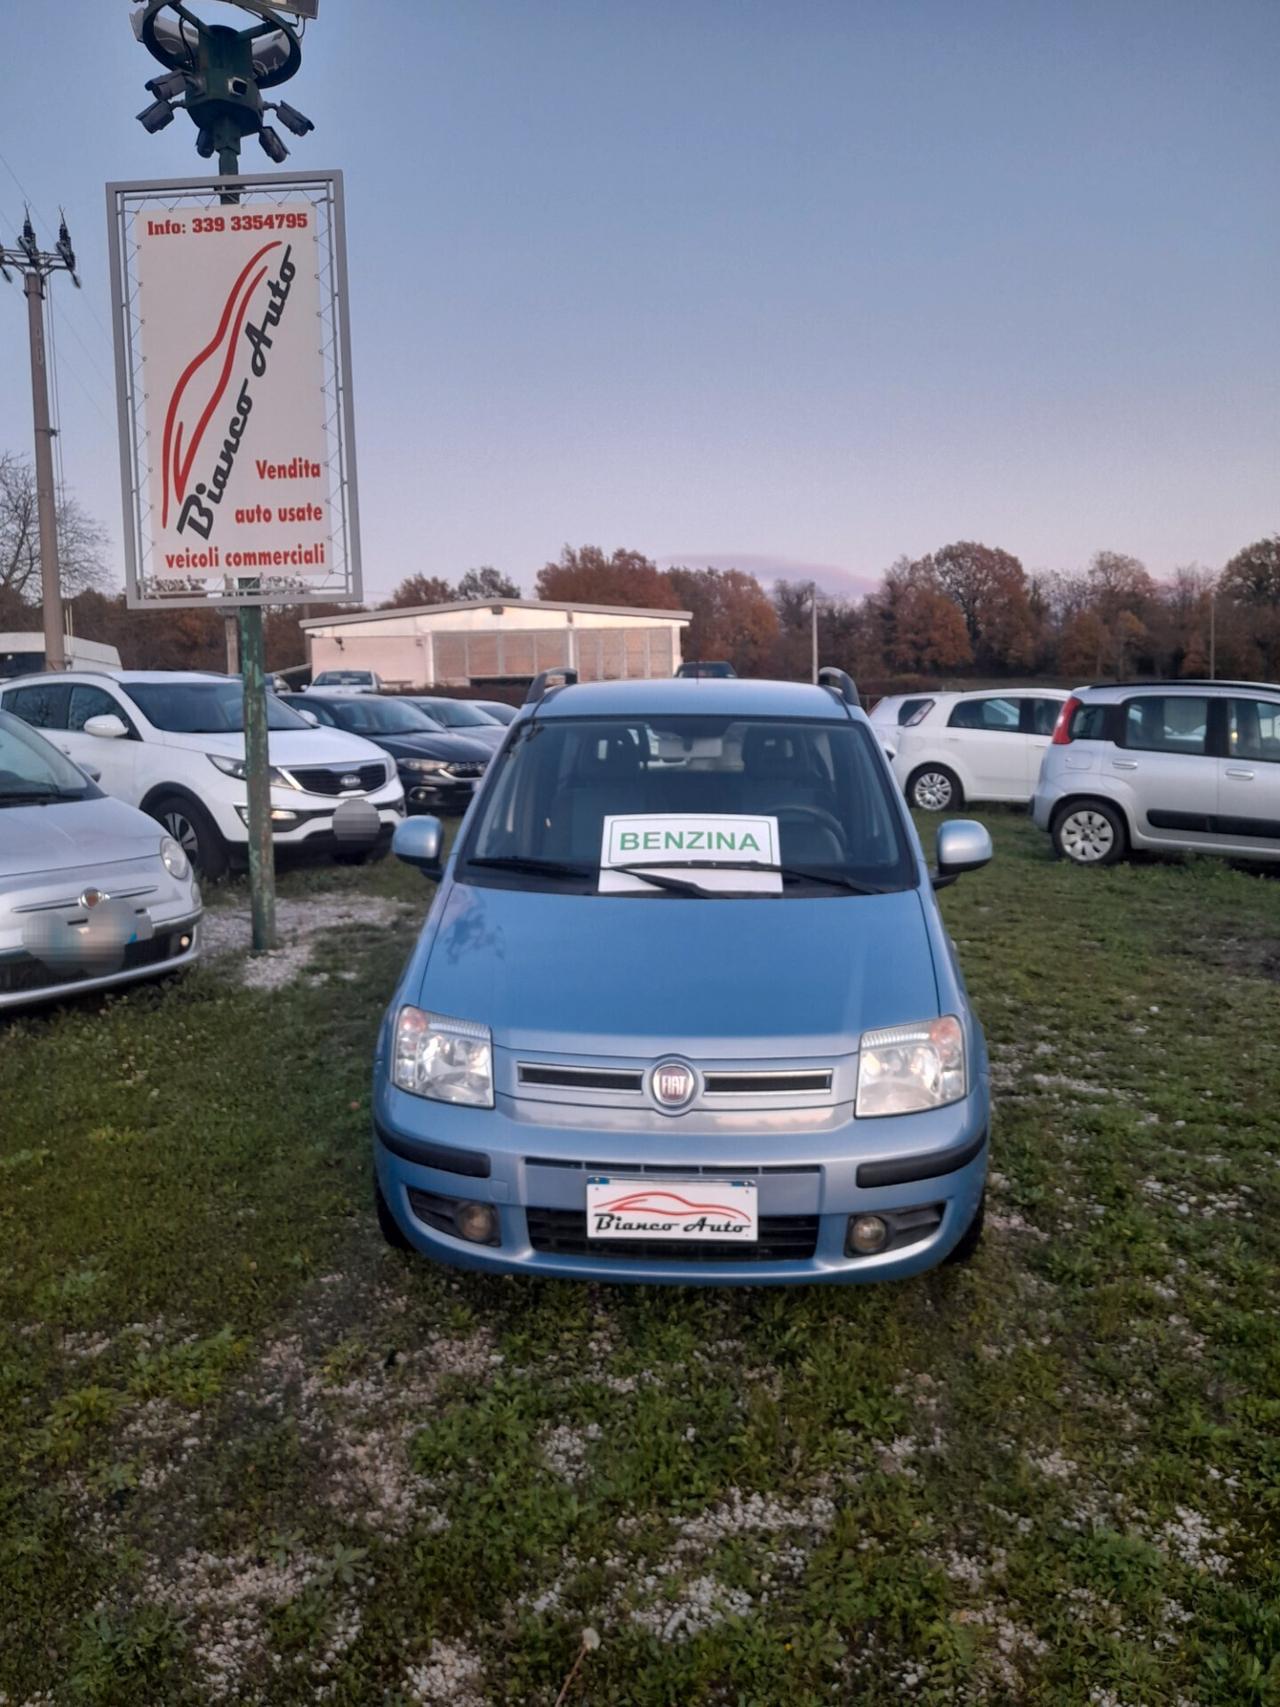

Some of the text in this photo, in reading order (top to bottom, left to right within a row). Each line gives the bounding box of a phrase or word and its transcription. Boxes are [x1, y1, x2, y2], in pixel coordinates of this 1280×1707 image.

[147, 213, 308, 236] Info: 339 3354795
[176, 244, 296, 540] Bianco Auto
[255, 457, 321, 480] Vendita
[235, 502, 323, 524] auto usate
[165, 543, 325, 569] veicoli commerciali
[619, 831, 761, 851] BENZINA
[661, 1075, 687, 1096] FIAT
[593, 1213, 752, 1233] Bianco Auto
